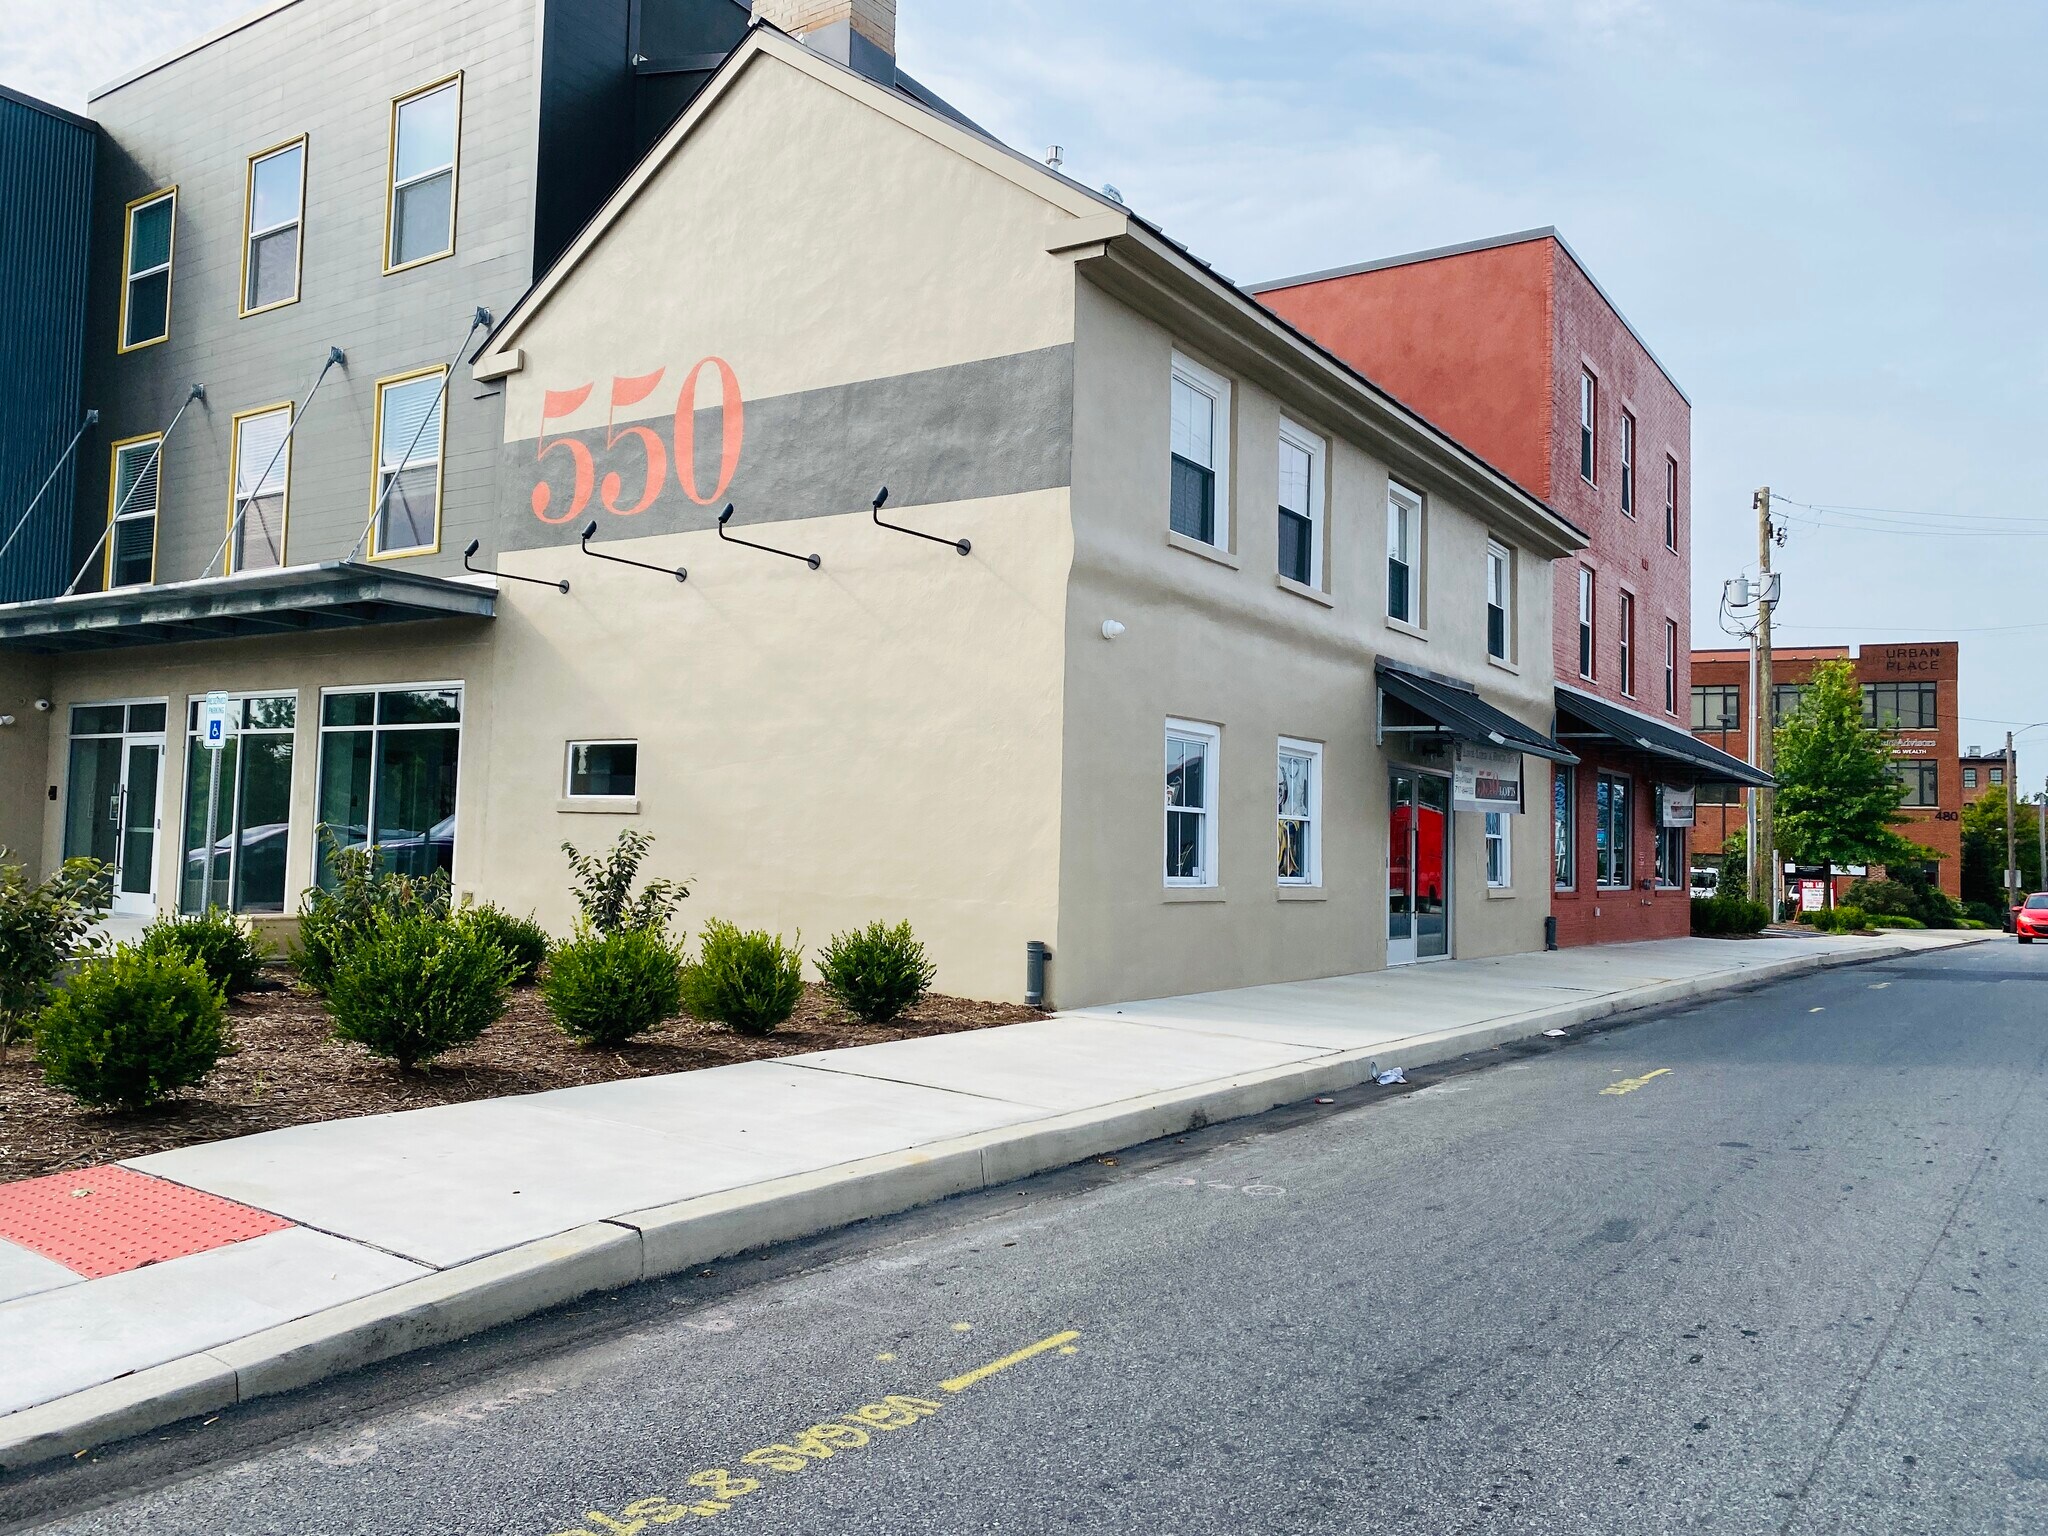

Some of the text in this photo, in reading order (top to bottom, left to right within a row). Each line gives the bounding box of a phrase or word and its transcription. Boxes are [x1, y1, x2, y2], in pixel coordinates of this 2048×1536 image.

[531, 356, 744, 524] 550
[1886, 648, 1940, 659] URBAN
[1886, 660, 1940, 671] PLACE
[1935, 811, 1958, 822] 480
